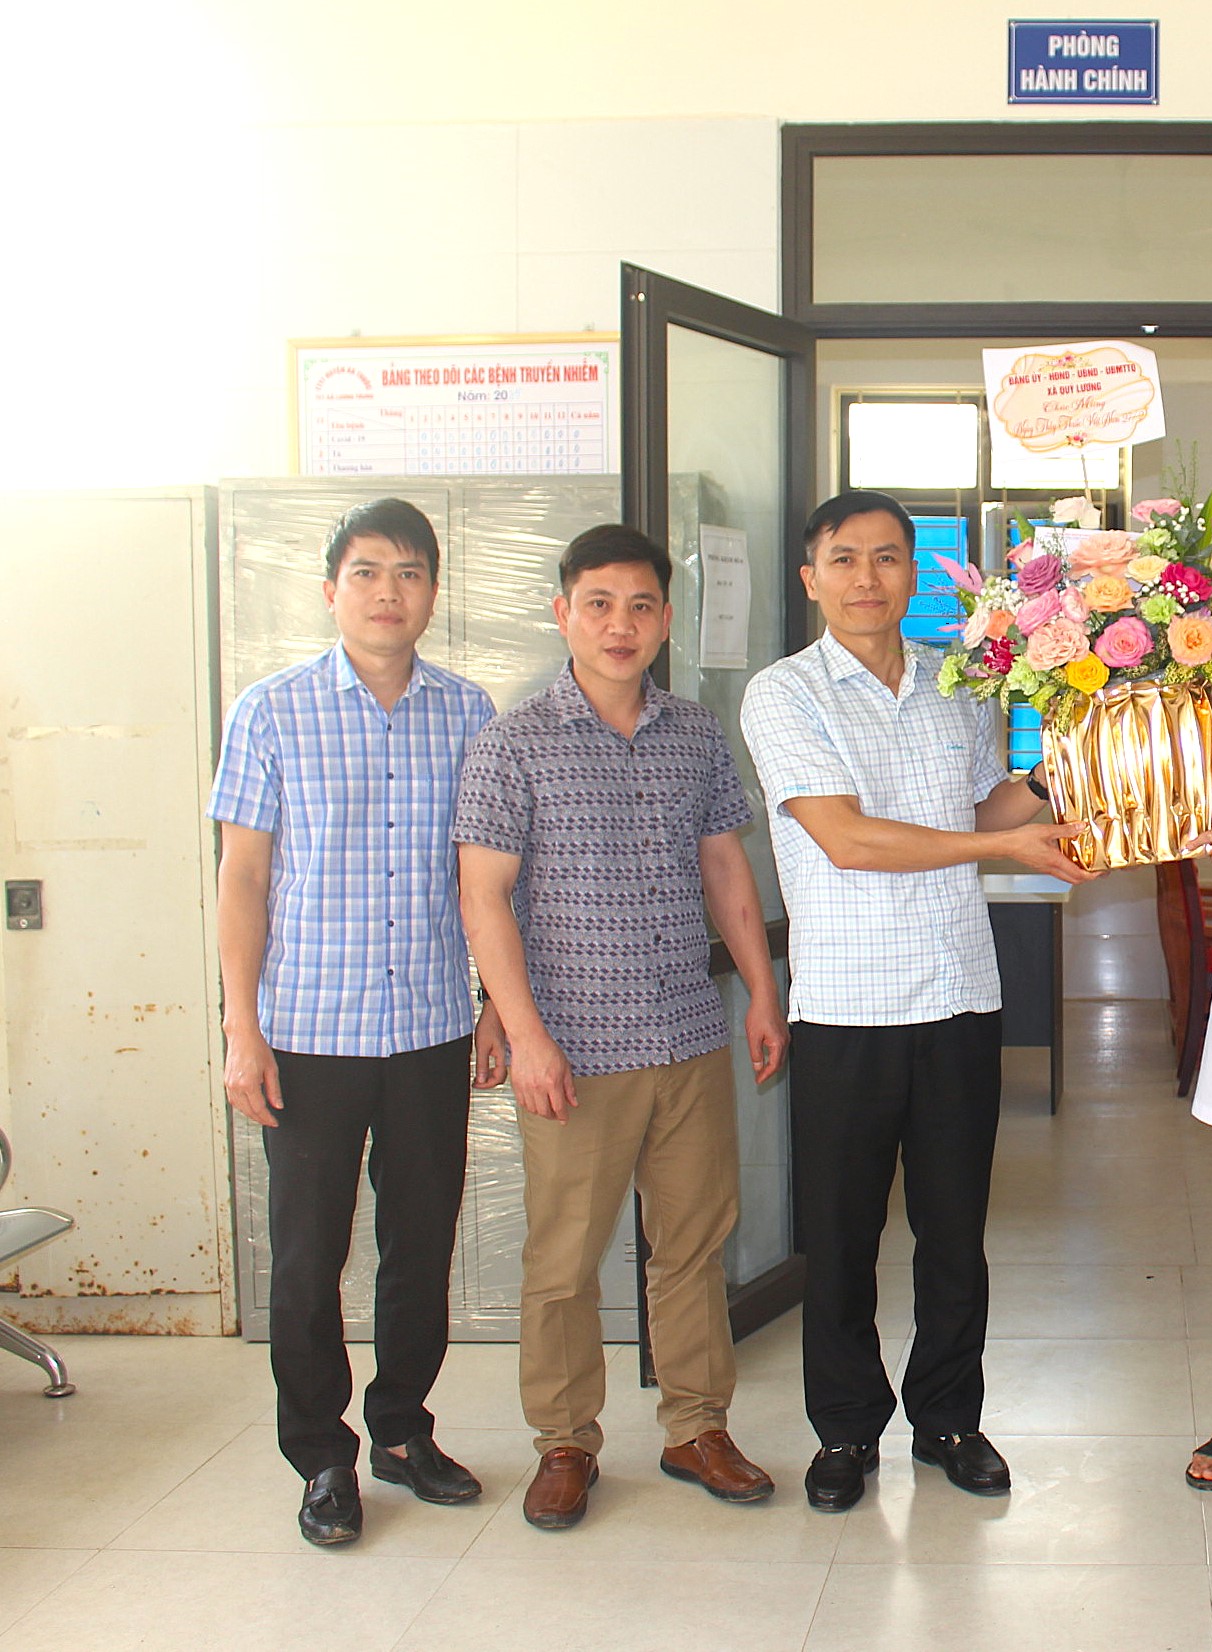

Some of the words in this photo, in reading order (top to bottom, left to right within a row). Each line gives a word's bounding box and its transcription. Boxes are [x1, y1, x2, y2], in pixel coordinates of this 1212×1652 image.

[1048, 30, 1119, 57] PHÒNG
[1020, 64, 1078, 91] HÀNH
[1083, 65, 1148, 91] CHÍNH
[382, 362, 411, 386] BẢNG
[415, 368, 440, 385] THEO
[443, 365, 460, 385] DÕI
[464, 364, 485, 384] CÁC
[488, 363, 517, 387] BỆNH
[564, 358, 599, 382] NHIỄM
[1077, 368, 1098, 378] UBND
[1105, 363, 1136, 375] UBMTTQ
